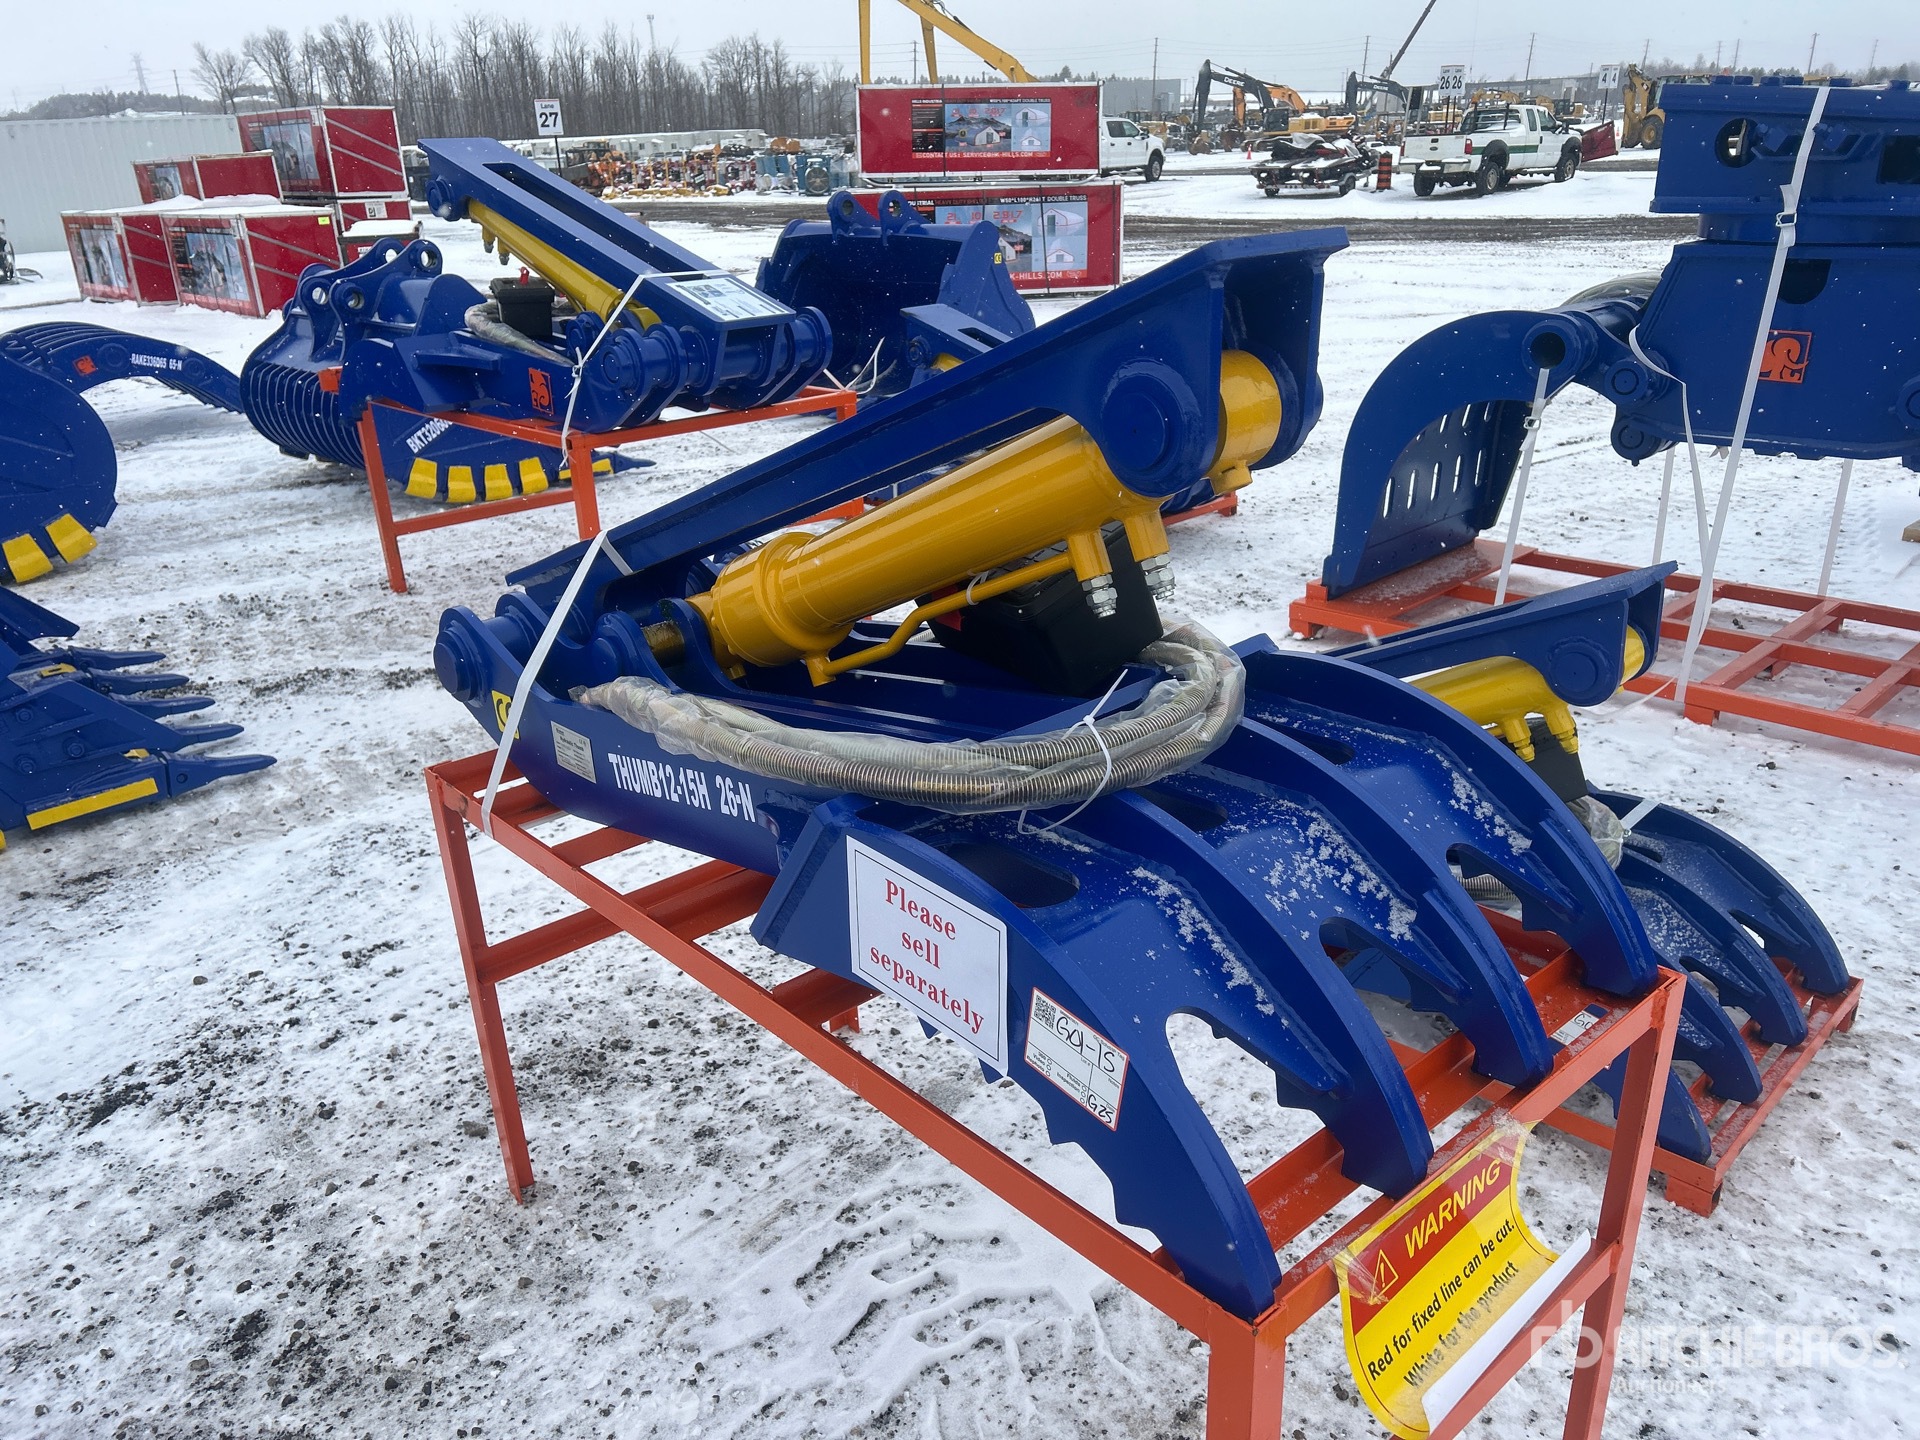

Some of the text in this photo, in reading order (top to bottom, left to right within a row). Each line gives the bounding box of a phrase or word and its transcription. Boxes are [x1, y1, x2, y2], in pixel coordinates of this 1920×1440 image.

[1224, 76, 1245, 87] DEERE
[1440, 75, 1450, 90] 26
[1452, 75, 1462, 90] 26
[1602, 72, 1607, 83] 4
[1612, 72, 1617, 83] 4
[539, 111, 559, 128] 27
[971, 211, 982, 220] 10
[607, 752, 712, 811] THUMB12-15H
[715, 774, 756, 823] 26-N
[885, 878, 956, 941] Please
[901, 931, 940, 969] sell
[870, 946, 985, 1034] separately
[1056, 1071, 1080, 1093] Inspection
[1066, 1073, 1080, 1087] Fluids
[1404, 1158, 1501, 1259] WARNING
[1367, 1218, 1515, 1381] Red for fixed line can be cut.
[1403, 1260, 1520, 1389] White for the product
